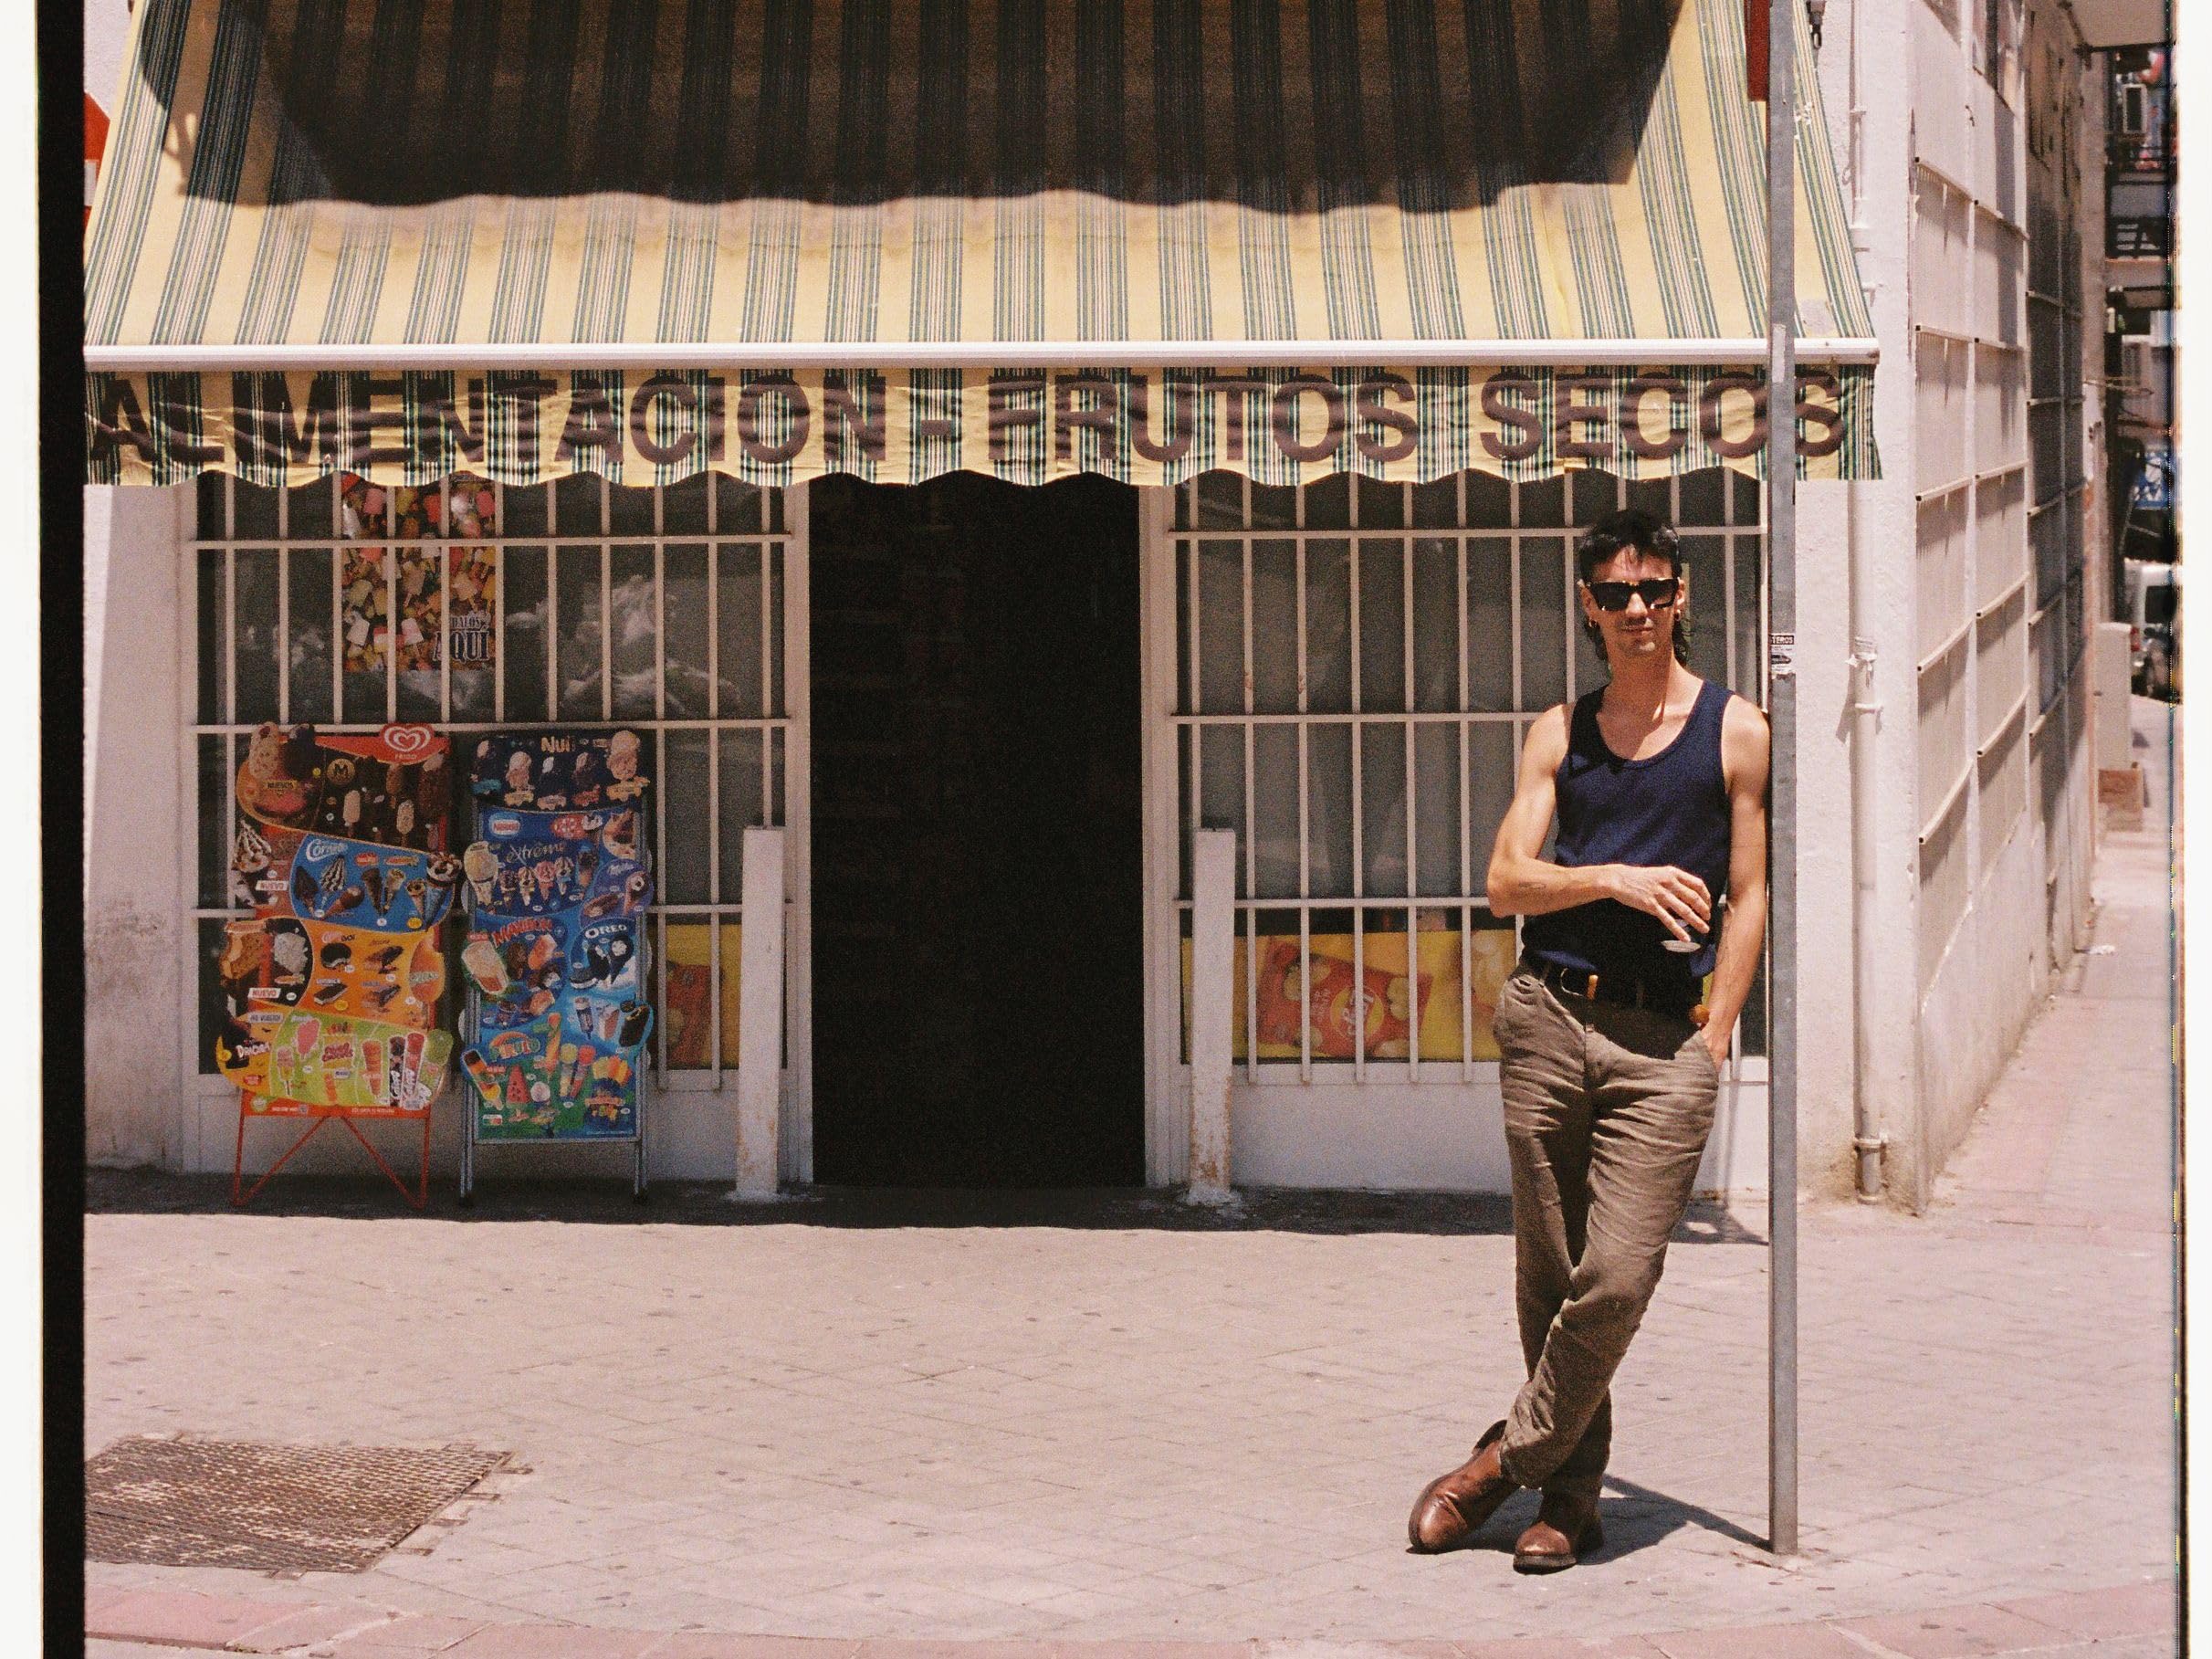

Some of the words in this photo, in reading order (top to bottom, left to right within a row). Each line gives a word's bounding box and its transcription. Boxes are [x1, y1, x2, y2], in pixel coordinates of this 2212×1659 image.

[90, 376, 886, 465] ALIMENTACION
[988, 373, 1418, 462] FRUTOS
[1480, 372, 1844, 459] SECOS
[584, 923, 628, 940] OREO
